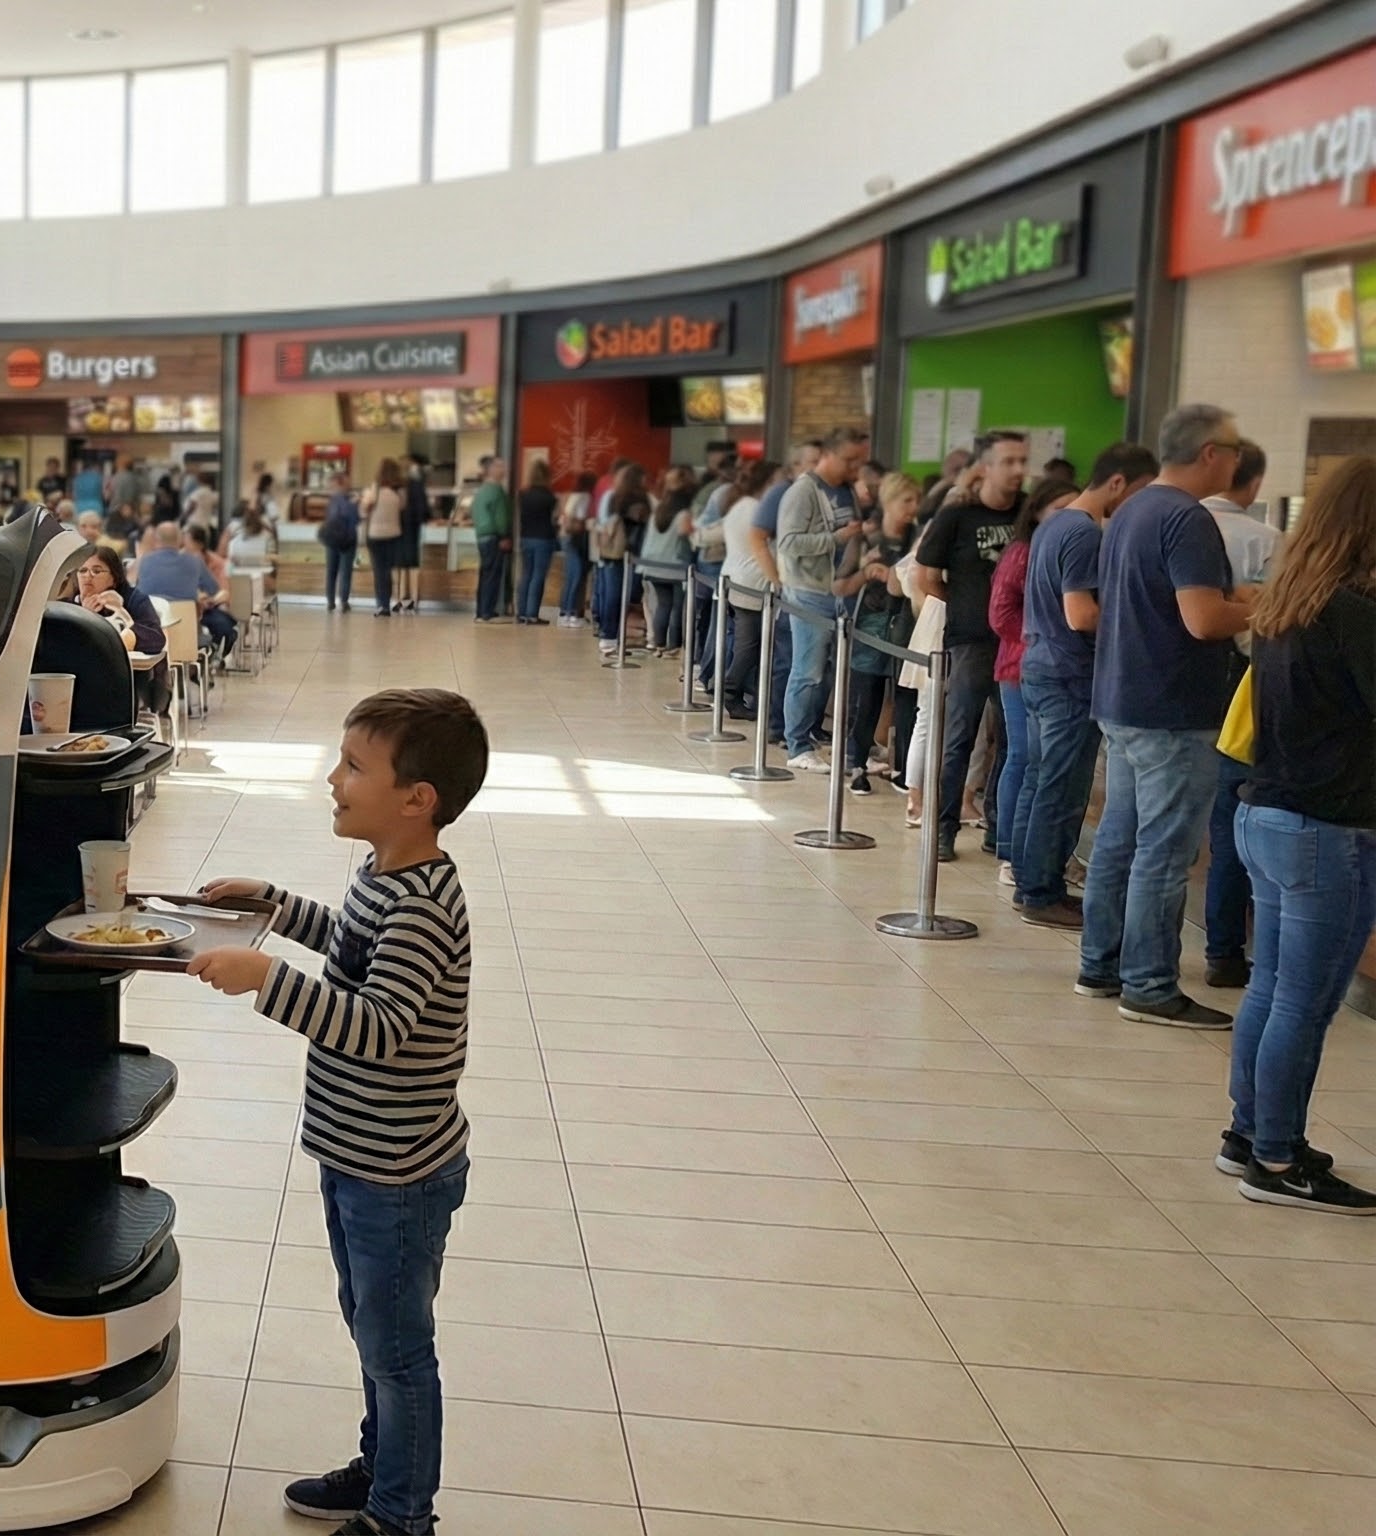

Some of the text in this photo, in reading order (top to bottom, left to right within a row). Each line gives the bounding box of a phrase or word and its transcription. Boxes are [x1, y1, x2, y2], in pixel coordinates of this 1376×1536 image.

[1209, 106, 1376, 238] Sprencep
[950, 217, 1061, 293] Salad Bar
[309, 341, 457, 374] Asian Cuisine
[590, 313, 717, 360] Salad Bar
[47, 350, 156, 387] Burgers
